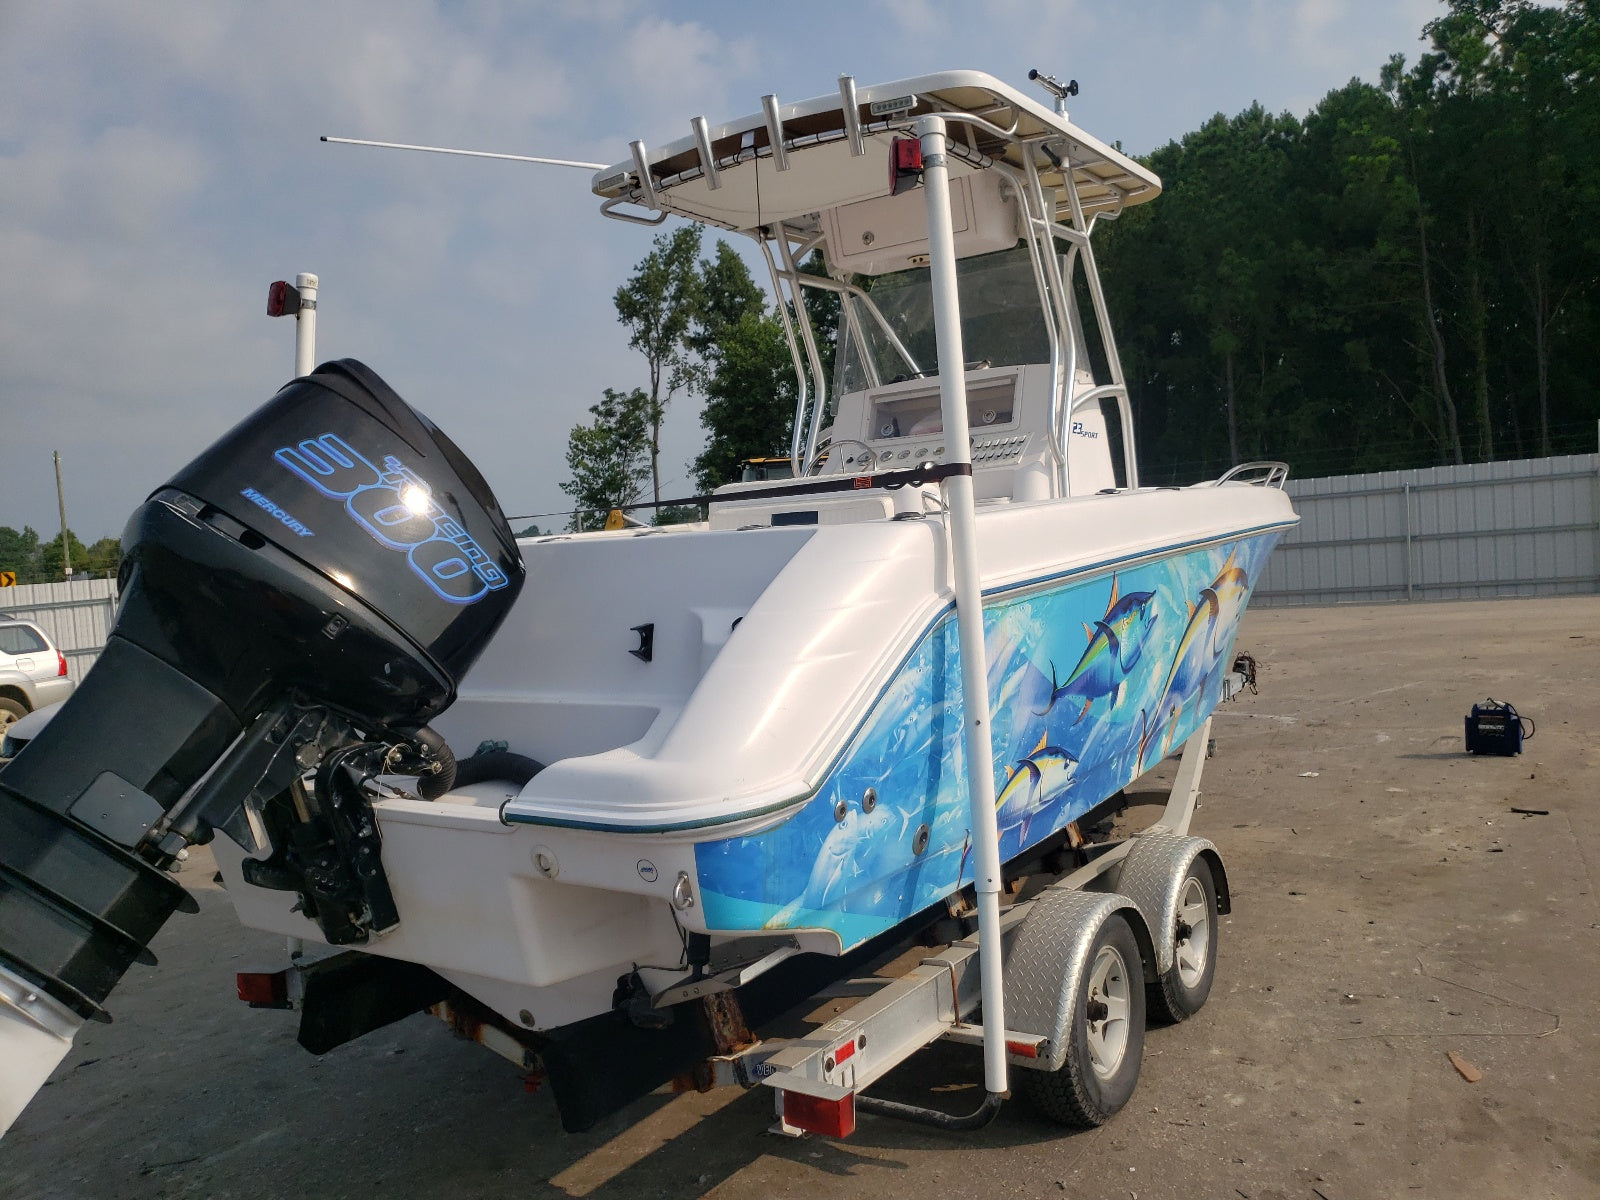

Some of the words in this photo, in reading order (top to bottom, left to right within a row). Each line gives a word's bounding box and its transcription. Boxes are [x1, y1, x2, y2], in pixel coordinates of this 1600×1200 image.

[1072, 422, 1082, 434] 23
[240, 487, 314, 537] MERCURY
[274, 433, 489, 603] 300
